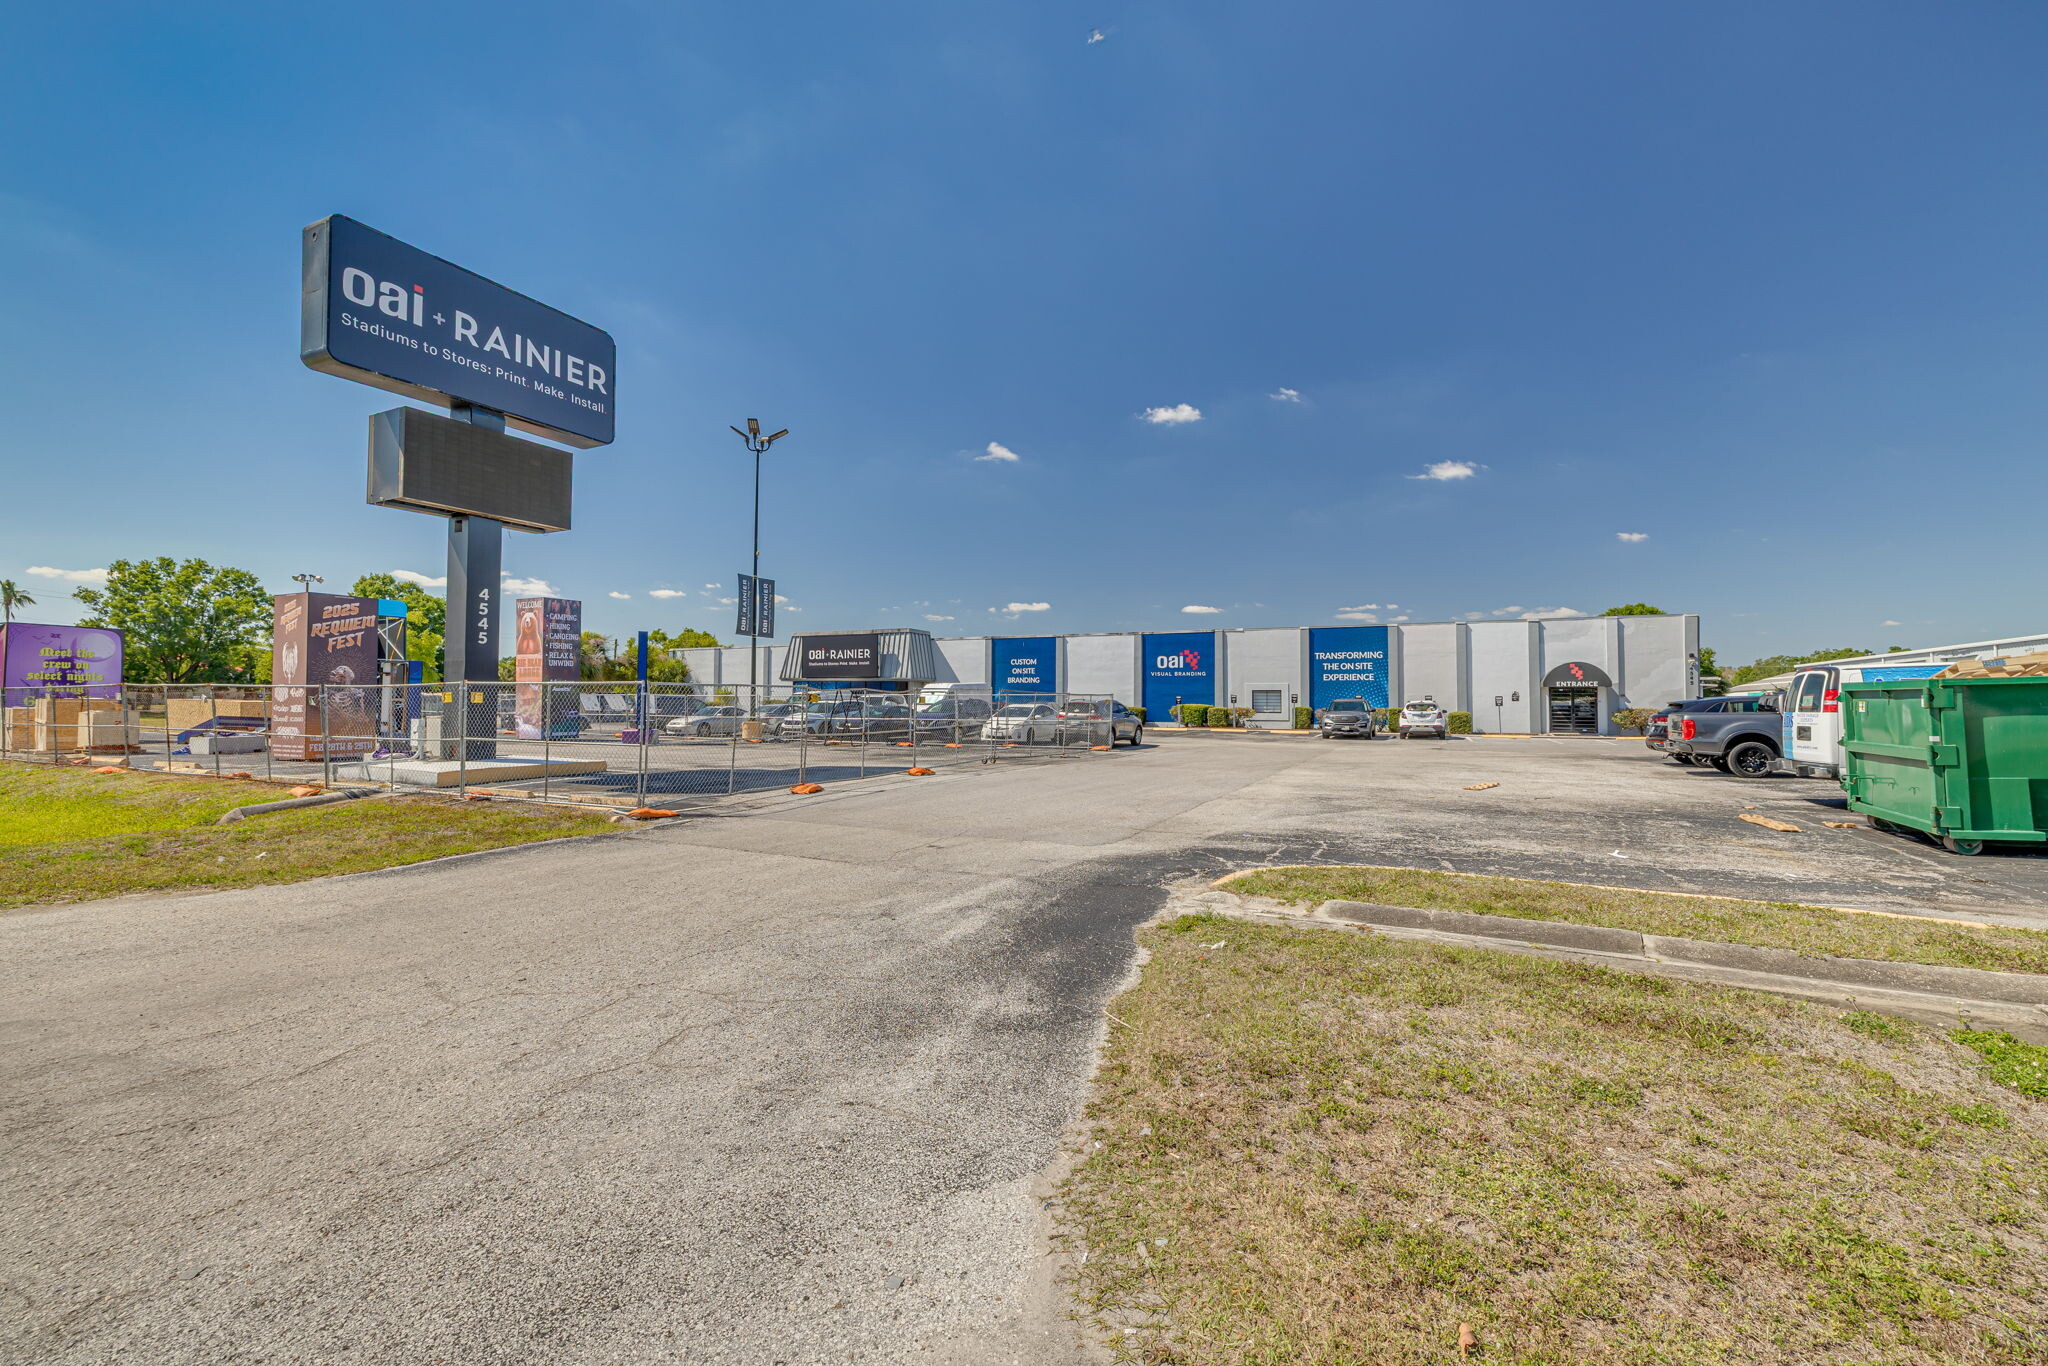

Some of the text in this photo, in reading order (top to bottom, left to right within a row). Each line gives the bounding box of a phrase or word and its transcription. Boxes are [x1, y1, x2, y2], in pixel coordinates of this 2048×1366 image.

[342, 267, 424, 327] oai
[454, 309, 608, 395] RAINIER
[341, 312, 607, 415] Stadiums to Stores: Print. Make. Install.
[322, 602, 360, 619] 2025
[478, 588, 490, 645] 4545
[550, 613, 577, 621] CAMPING
[310, 614, 376, 638] REQUIEM
[328, 631, 364, 652] FEST
[39, 647, 96, 659] Meet the
[809, 648, 824, 660] oai
[830, 649, 870, 659] RAINIER
[1314, 651, 1383, 660] TRANSFORMING
[42, 661, 71, 669] crew
[1157, 652, 1183, 668] oai
[1355, 662, 1373, 670] SITE
[26, 671, 104, 683] select nights
[1323, 673, 1375, 681] EXPERIENCE
